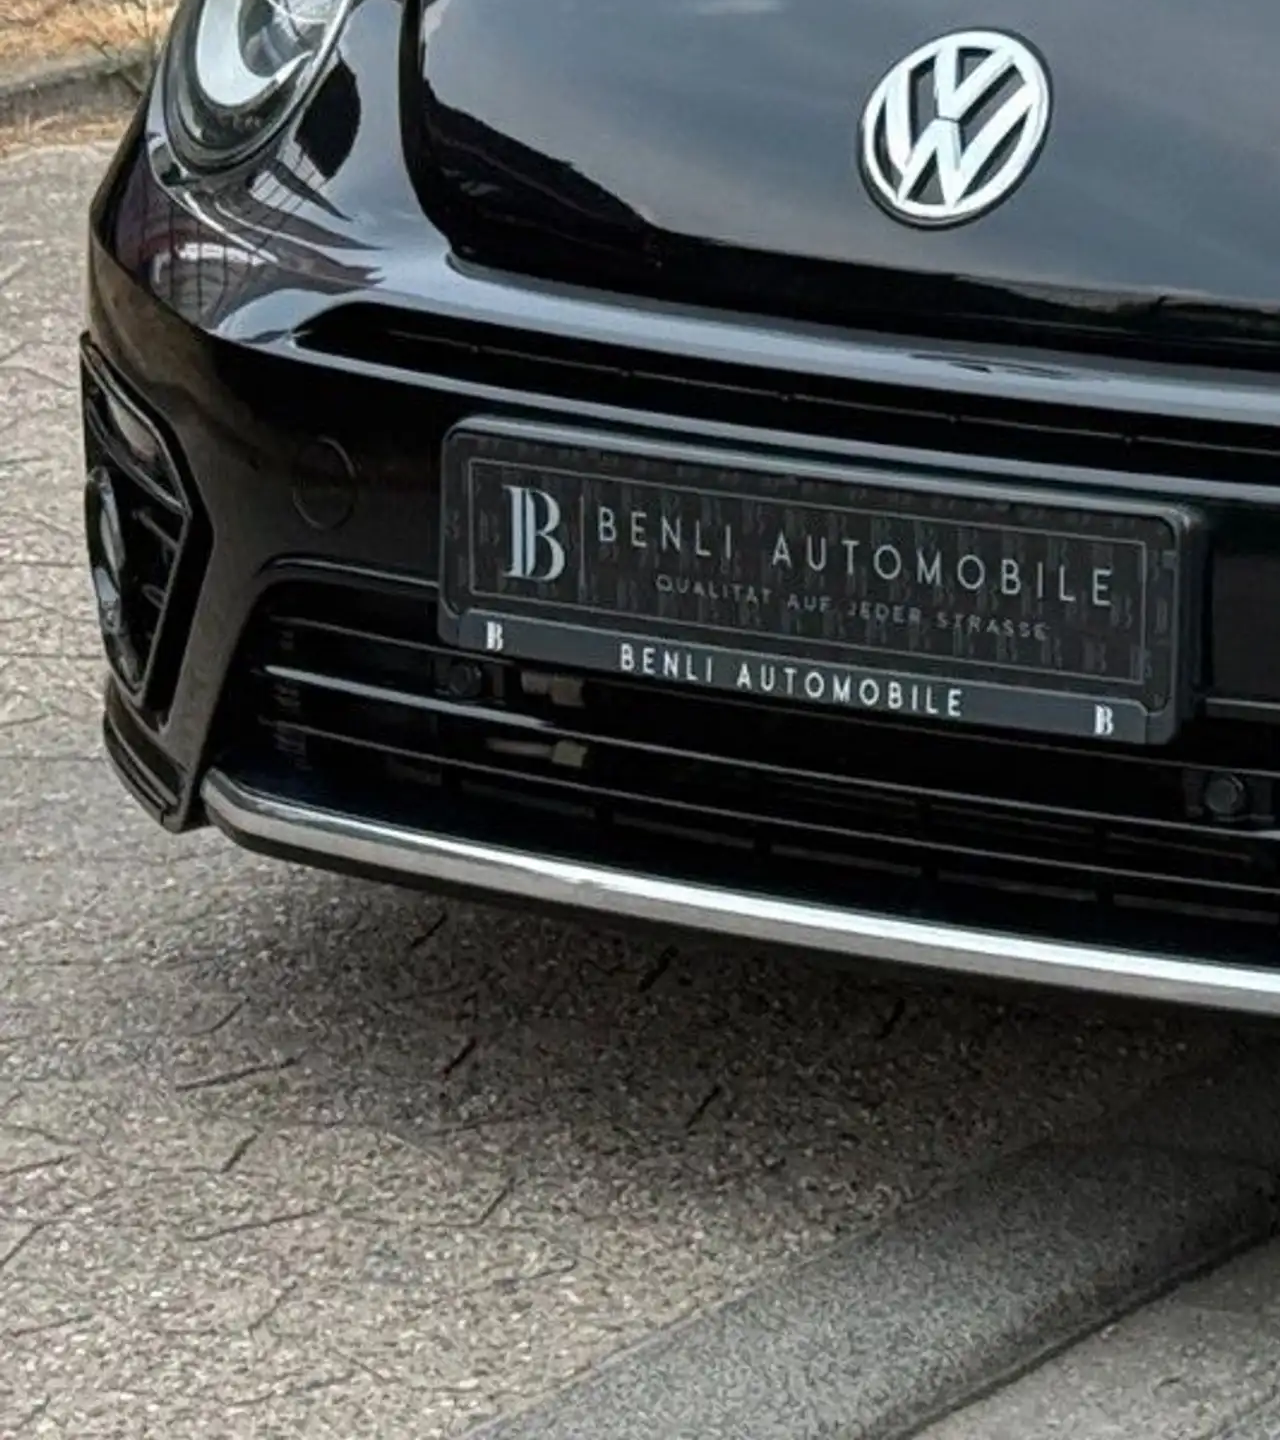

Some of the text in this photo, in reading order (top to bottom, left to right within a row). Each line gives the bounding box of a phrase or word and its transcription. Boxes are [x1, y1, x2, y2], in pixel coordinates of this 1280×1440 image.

[598, 506, 733, 560] BENLI
[770, 528, 1114, 608] AUTOMOBILE
[786, 593, 832, 614] AUF
[847, 599, 923, 628] JEDER
[936, 612, 1051, 642] STRASSE
[620, 642, 713, 684] BENLI
[736, 662, 962, 718] AUTOMOBILE
